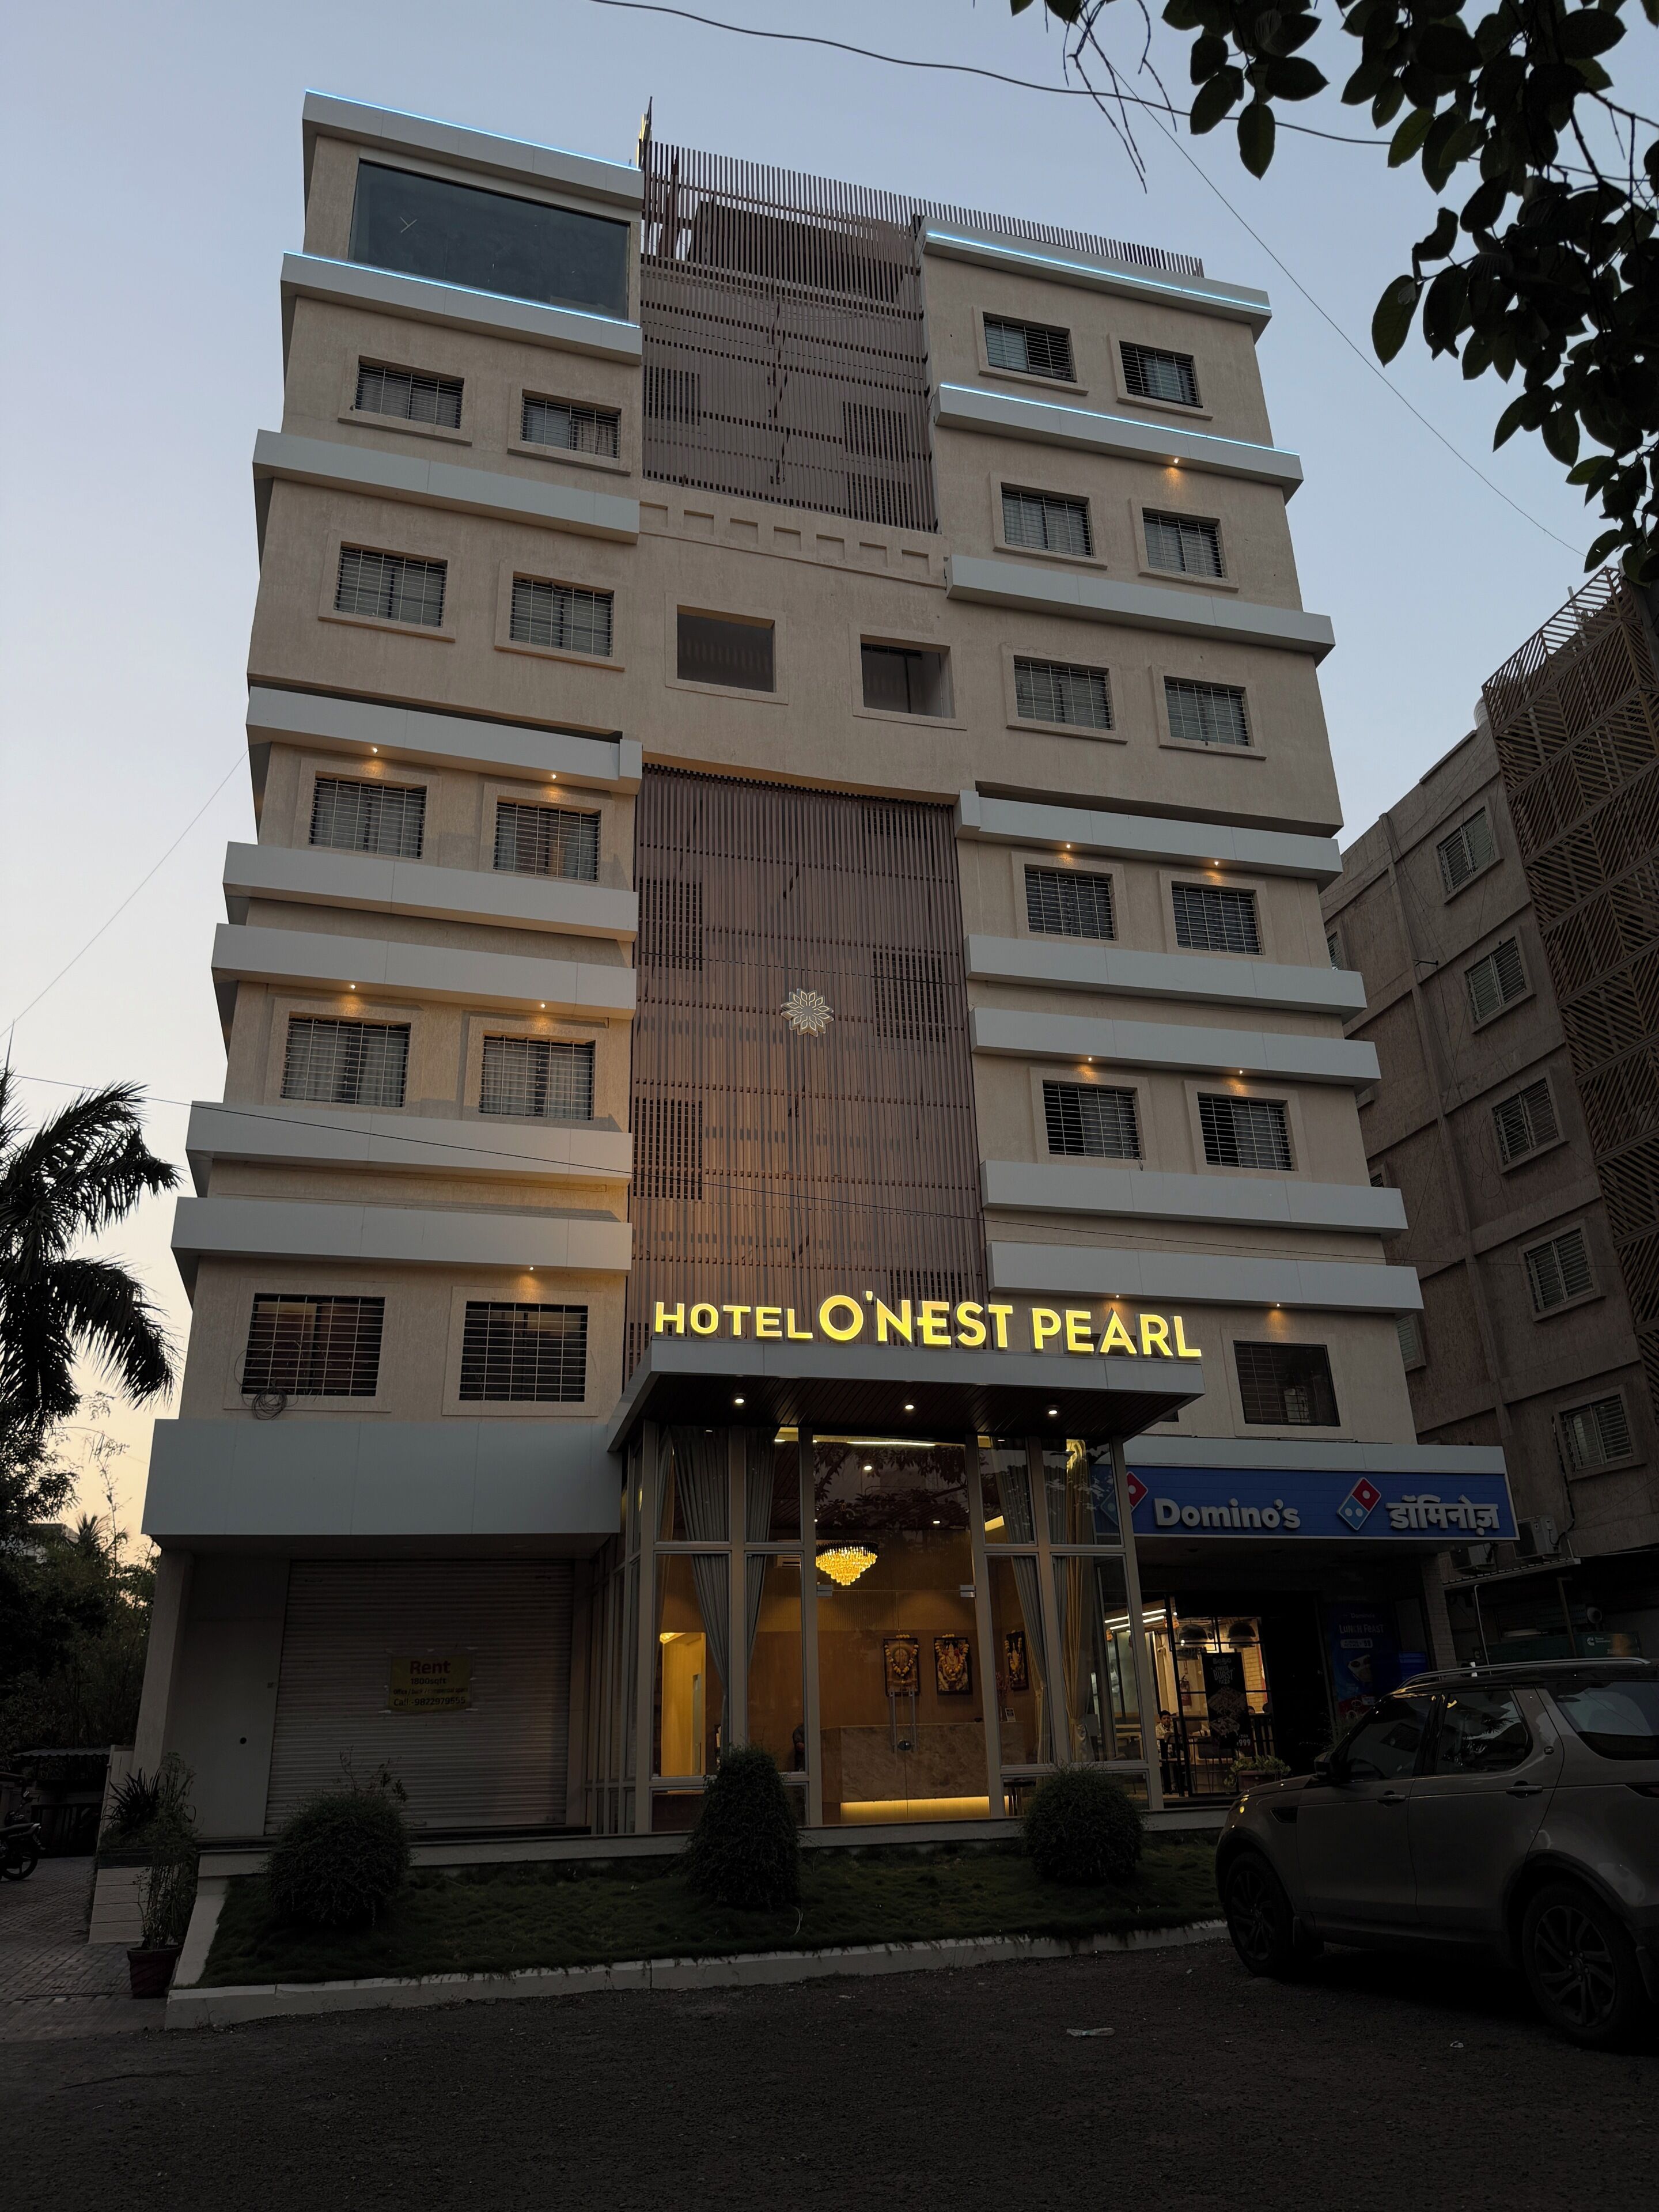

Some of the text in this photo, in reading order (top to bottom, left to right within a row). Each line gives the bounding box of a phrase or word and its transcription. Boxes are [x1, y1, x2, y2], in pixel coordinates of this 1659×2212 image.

[654, 1290, 1203, 1357] HOTEL O'NEST PEARL
[1154, 1498, 1301, 1529] Domino's
[1385, 1494, 1500, 1536] डॉमिनोज़
[1339, 1623, 1363, 1634] LUNH
[410, 1660, 451, 1674] Rent
[1213, 1669, 1233, 1681] BURST
